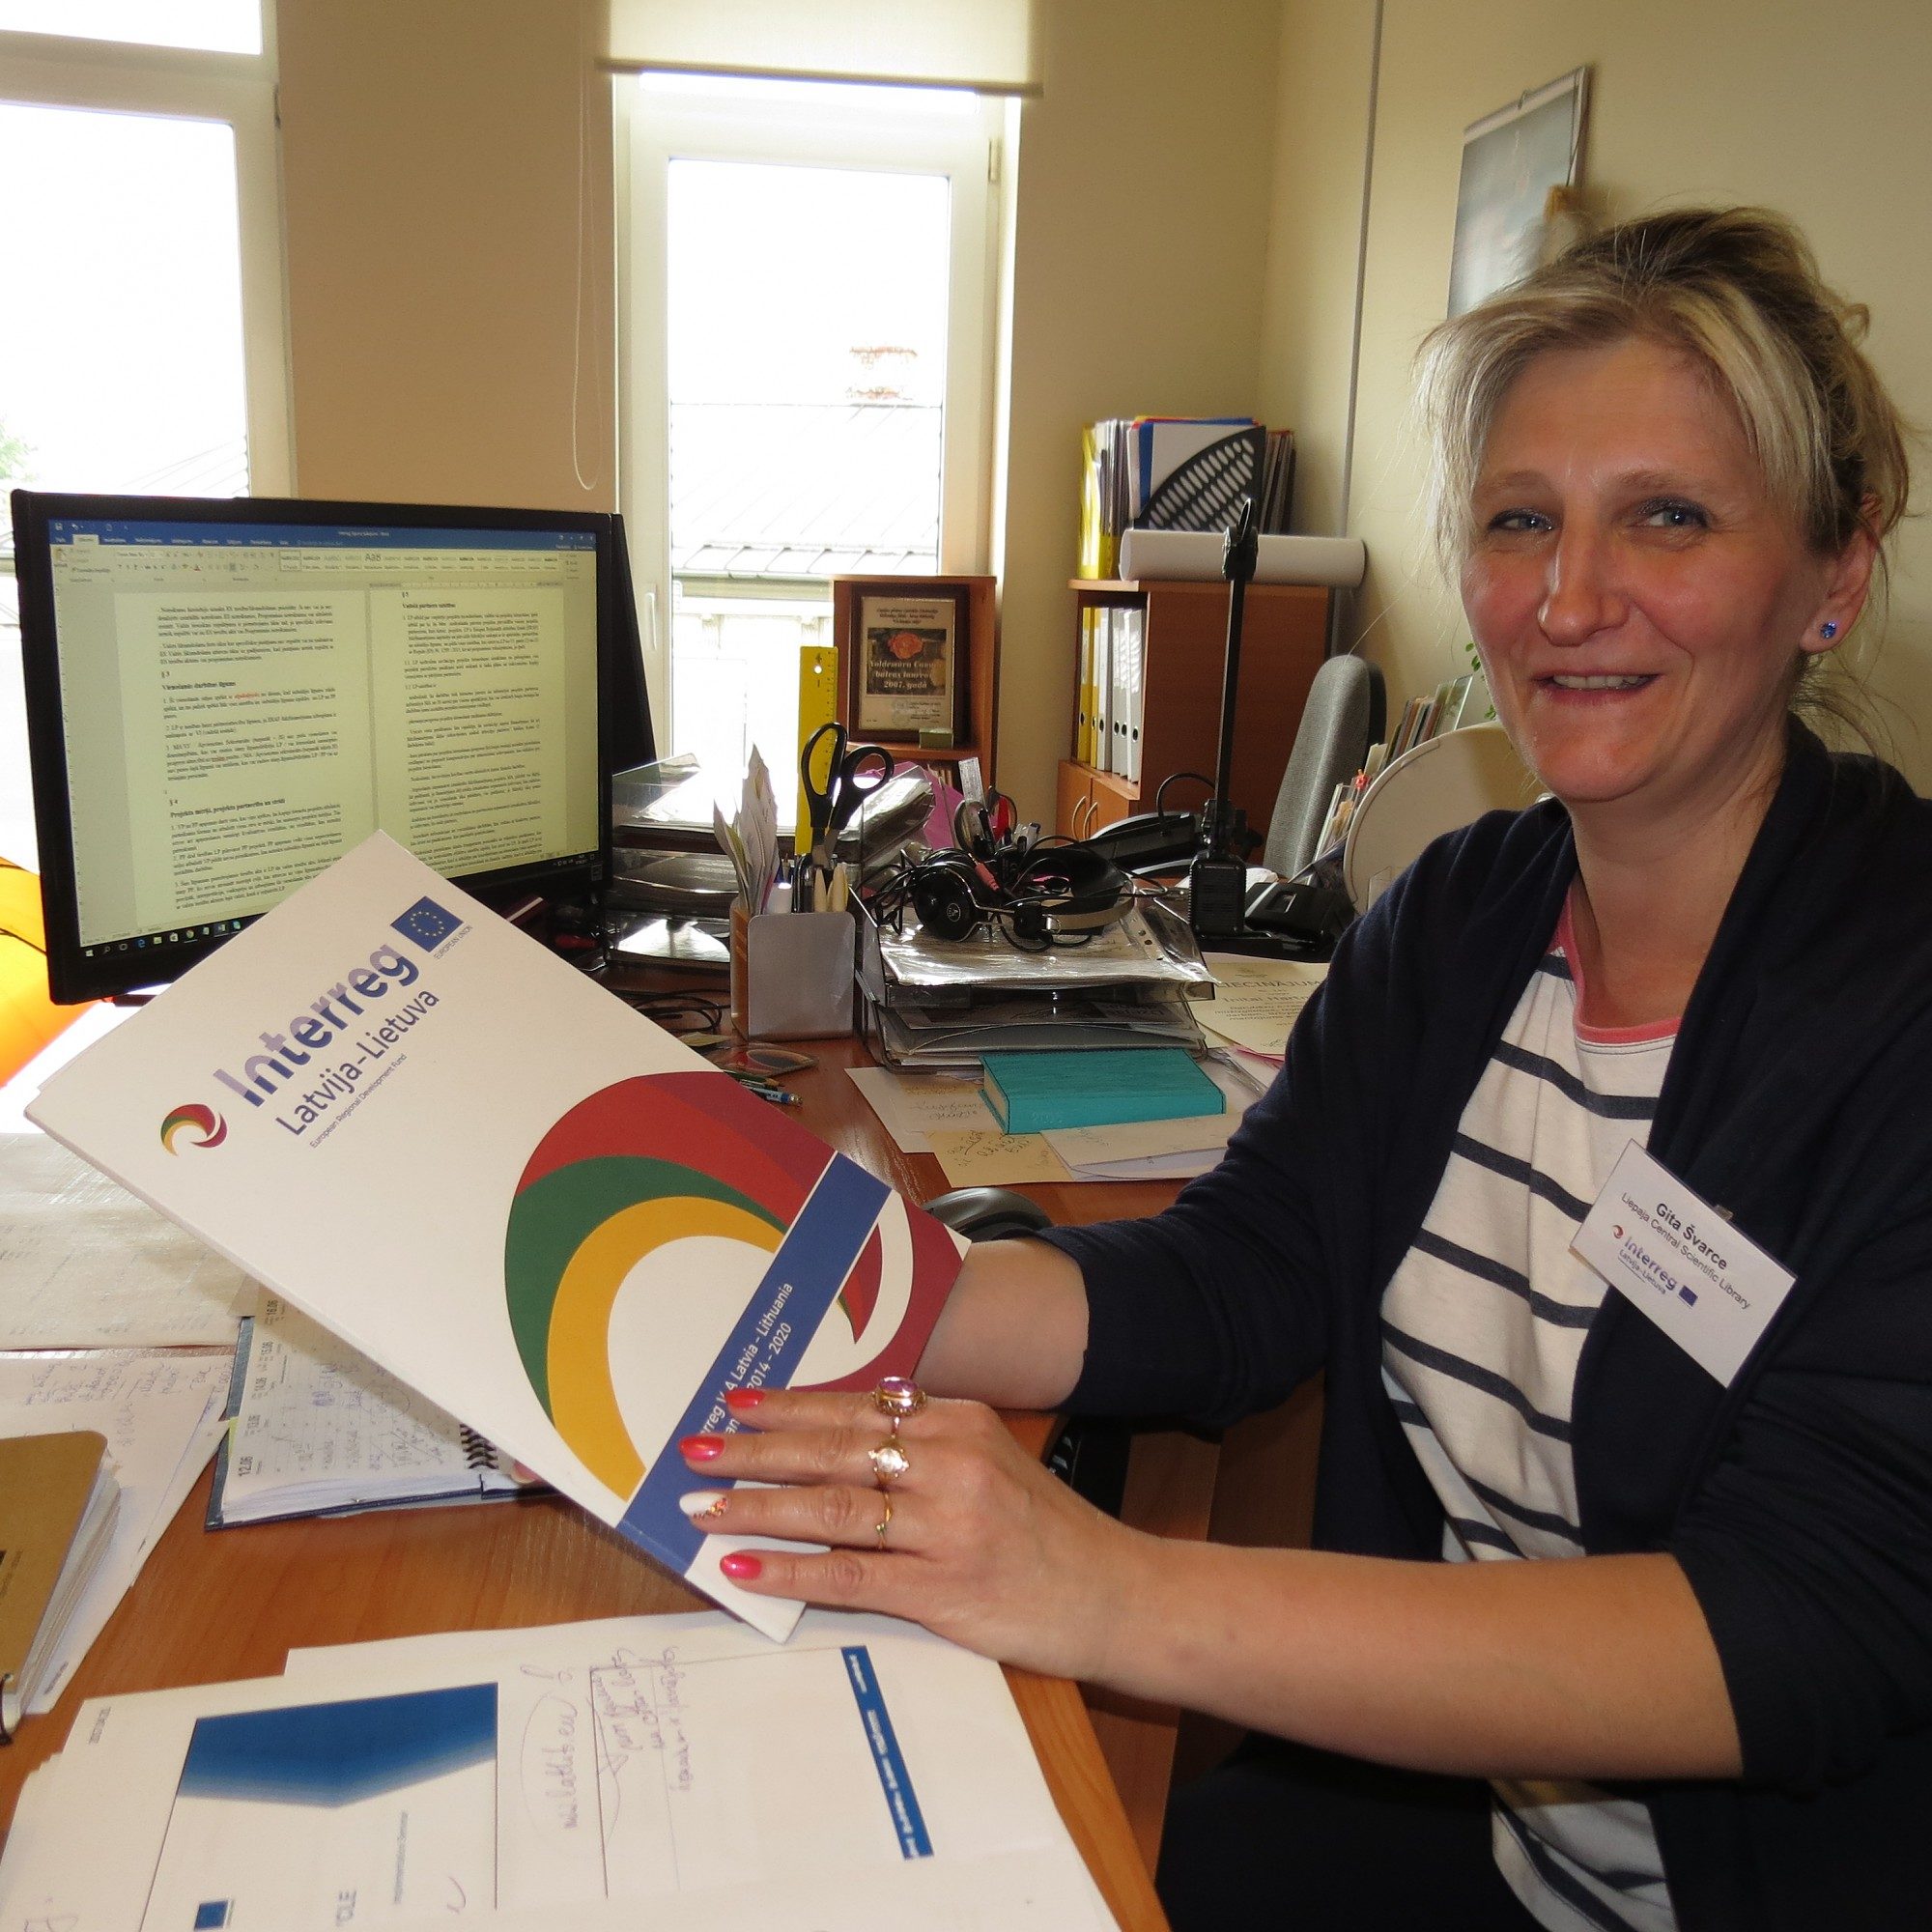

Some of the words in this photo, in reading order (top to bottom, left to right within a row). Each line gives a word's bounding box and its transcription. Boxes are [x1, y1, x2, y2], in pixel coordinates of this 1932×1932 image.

[213, 944, 421, 1107] Interreg
[309, 1121, 338, 1149] European
[336, 1097, 360, 1122] Regional
[358, 1066, 394, 1100] Development
[391, 1053, 408, 1068] Fund
[1624, 1236, 1678, 1291] Interreg
[1650, 1219, 1680, 1249] Central
[1680, 1245, 1719, 1283] Scientific
[1719, 1278, 1751, 1310] Library
[1656, 1203, 1682, 1231] Gita
[1683, 1224, 1728, 1270] Švarce
[730, 1343, 758, 1380] Latvia
[756, 1283, 793, 1337] Lithuania
[768, 1322, 792, 1355] 2020
[239, 1456, 254, 1477] 12.06
